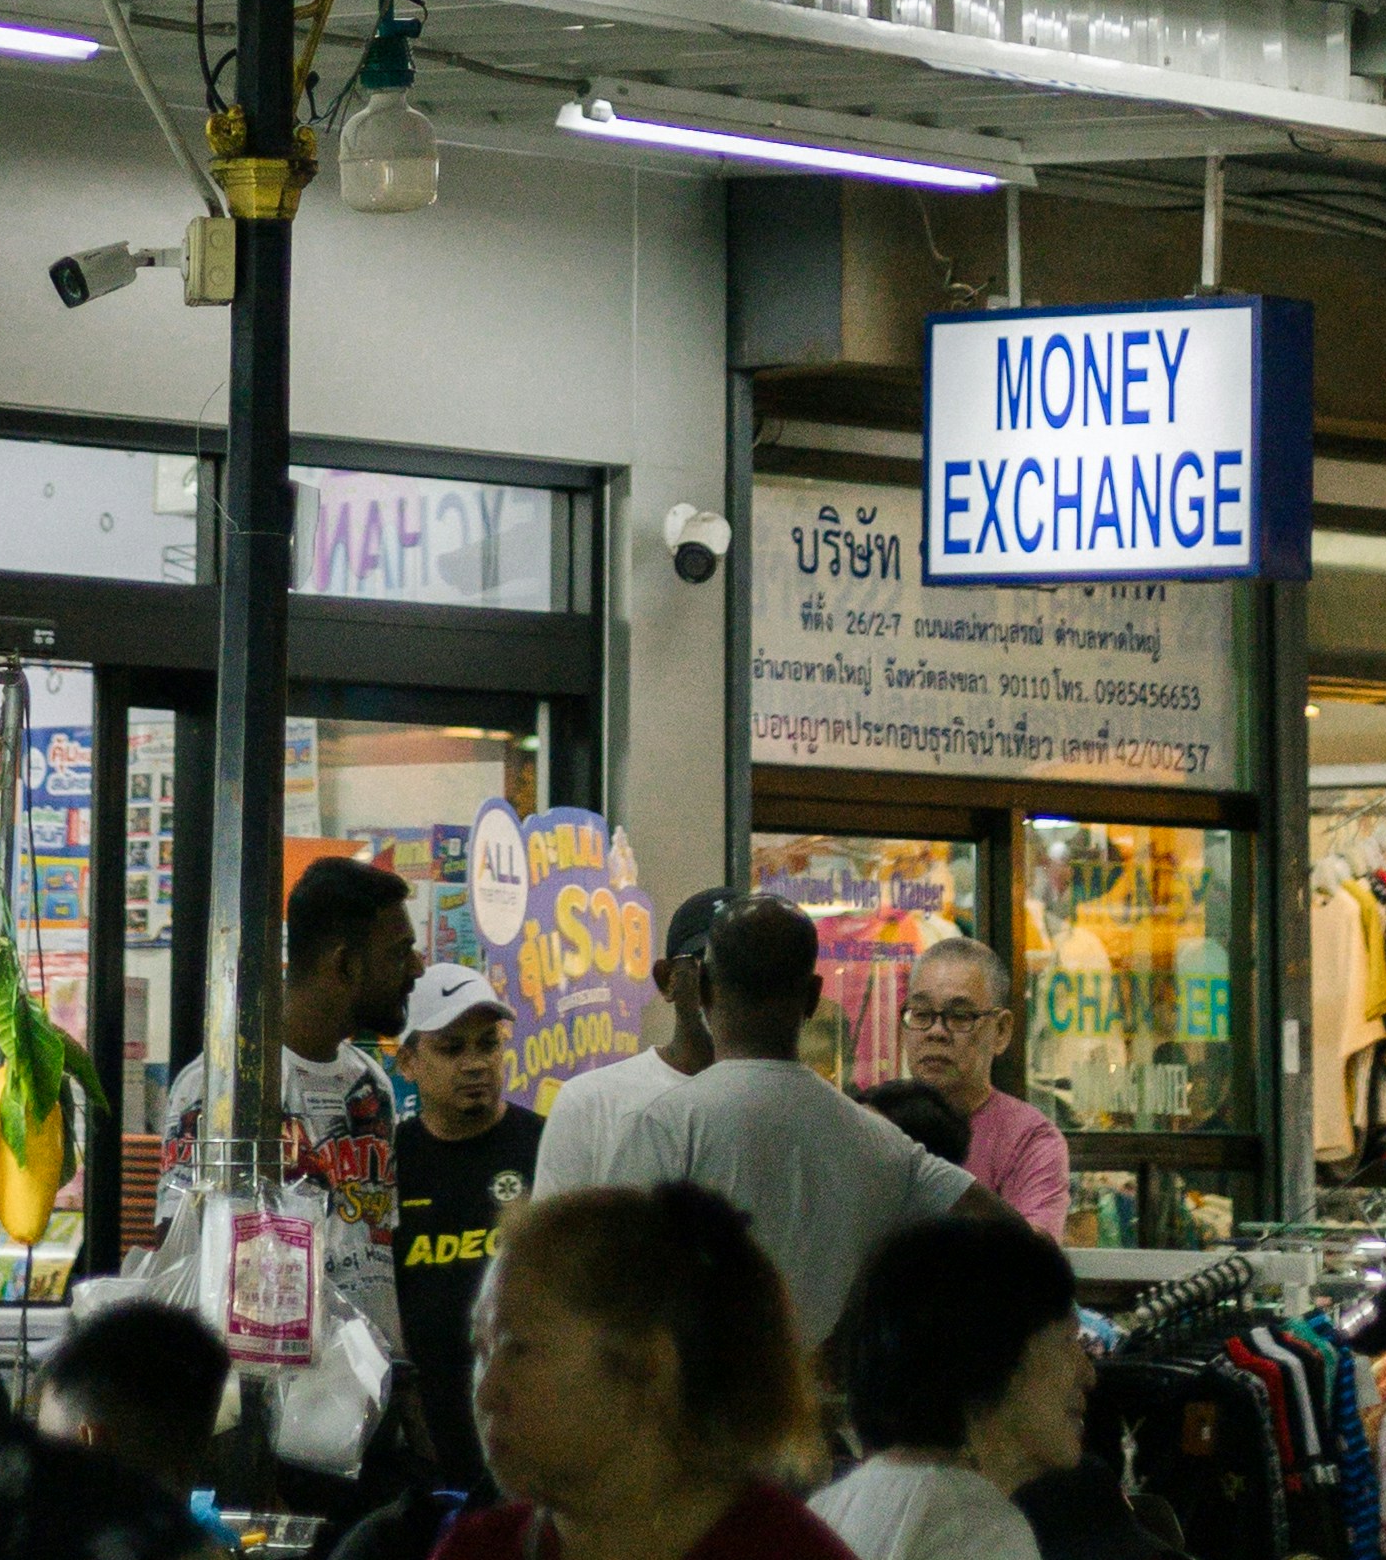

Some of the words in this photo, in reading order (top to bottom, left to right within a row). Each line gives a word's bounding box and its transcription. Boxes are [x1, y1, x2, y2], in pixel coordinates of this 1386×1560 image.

[996, 327, 1191, 432] MONEY
[943, 449, 1244, 555] EXCHANGE
[792, 505, 901, 581] บริษัท
[800, 600, 833, 632] ที่ตั้ง
[846, 609, 901, 639] 26/2-7
[999, 676, 1050, 699] 90110
[478, 841, 521, 885] ALL
[502, 1012, 613, 1093] 2,000,000
